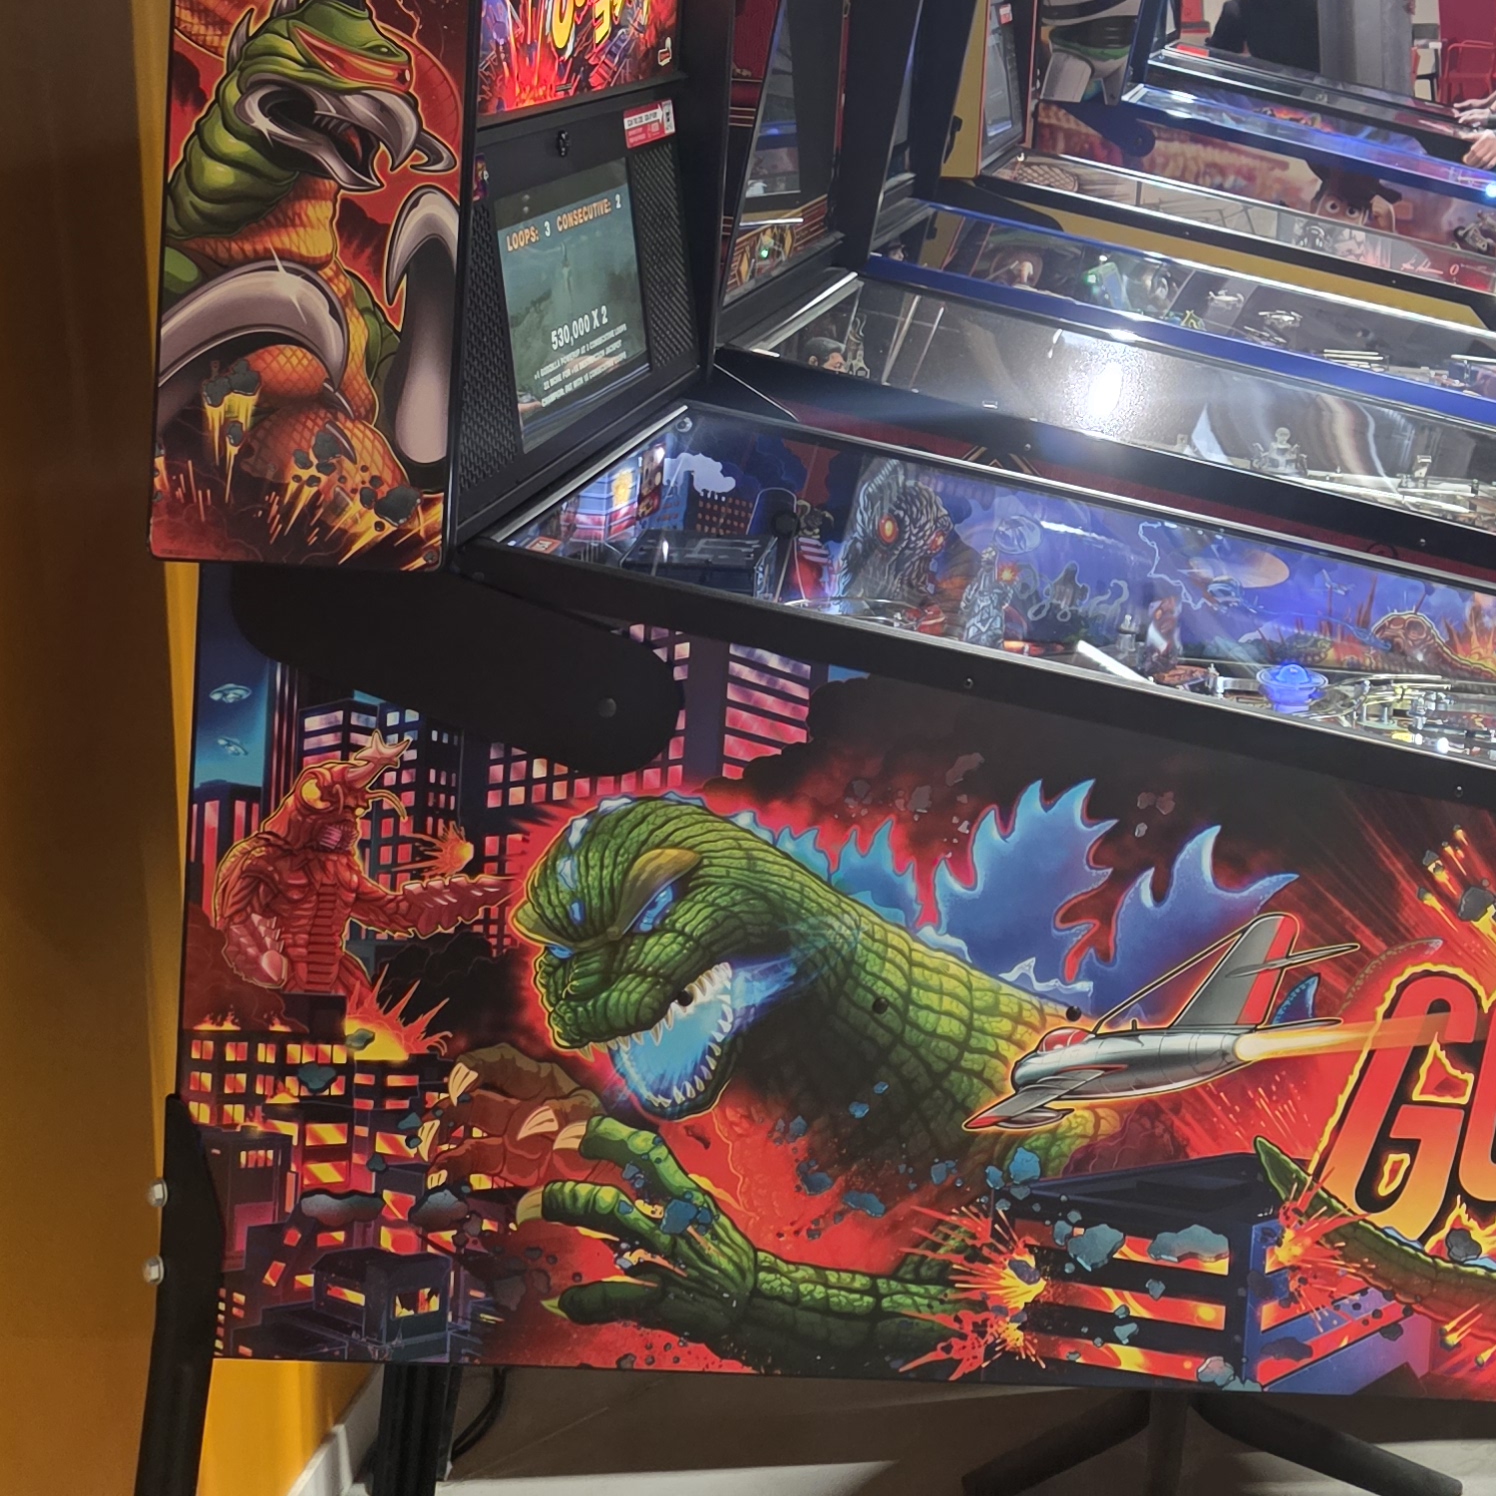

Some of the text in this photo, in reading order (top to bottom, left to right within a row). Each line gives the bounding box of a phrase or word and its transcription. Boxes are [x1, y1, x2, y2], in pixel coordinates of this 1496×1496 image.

[506, 193, 621, 252] LOOPS: 3 CONSECUTIVE: 2
[551, 305, 608, 350] 530,000 X 2
